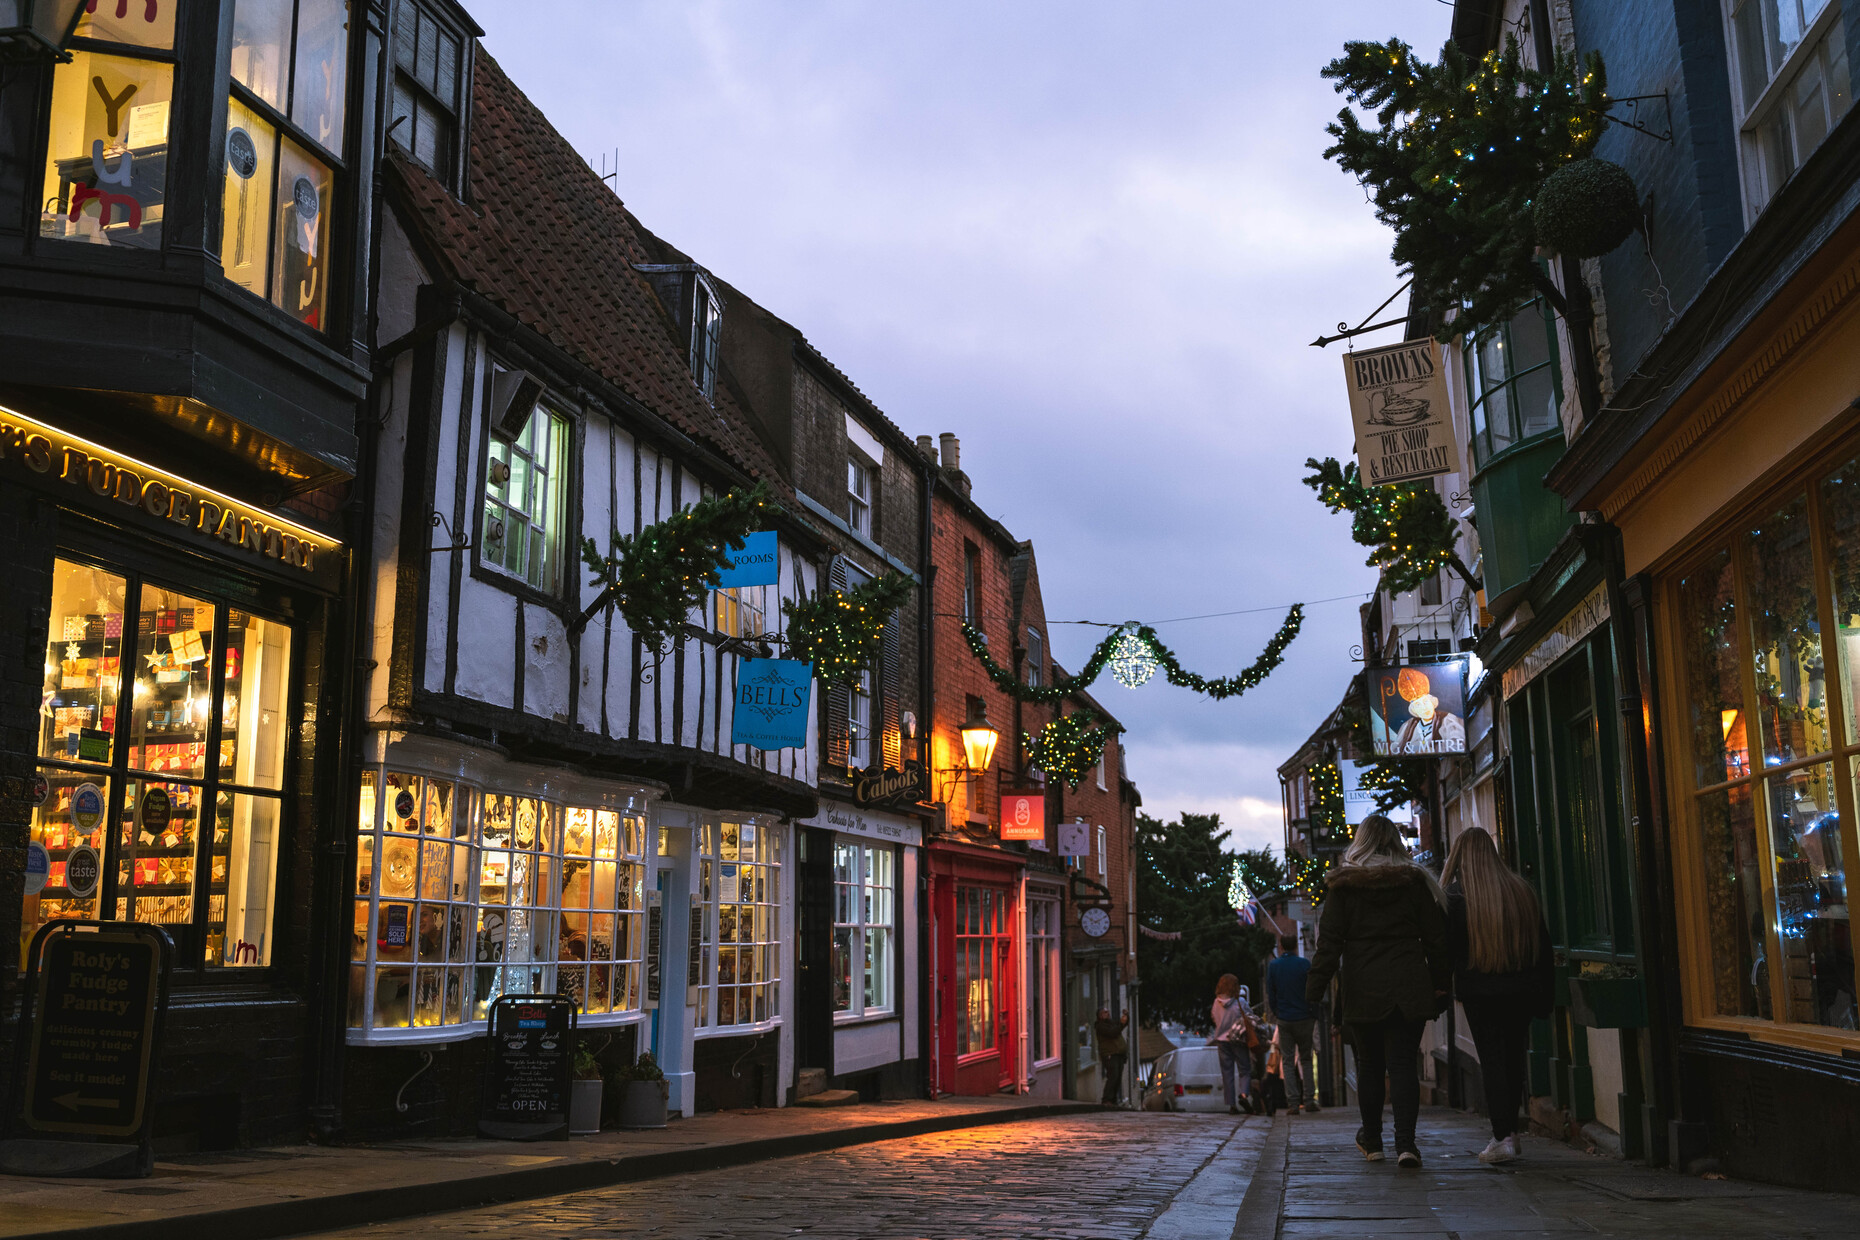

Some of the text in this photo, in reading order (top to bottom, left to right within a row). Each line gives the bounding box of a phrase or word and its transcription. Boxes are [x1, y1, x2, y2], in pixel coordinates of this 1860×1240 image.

[231, 142, 254, 167] taste
[296, 189, 316, 210] taste
[1354, 346, 1434, 387] BROWNS
[1381, 427, 1430, 455] PIE SHOP
[1370, 445, 1449, 478] & RESTAURANT
[61, 445, 192, 527] FUDGE
[197, 499, 319, 572] PANTRY
[734, 553, 774, 566] ROOMS
[740, 683, 807, 708] BELLS'
[1374, 738, 1465, 756] WIG & MITRE
[857, 770, 919, 802] Cahoots
[149, 802, 166, 811] Fudge
[150, 793, 166, 802] Vegan
[70, 866, 96, 878] taste
[71, 950, 130, 972] Roly's
[68, 972, 128, 994] Fudge
[61, 993, 131, 1016] Pantry
[46, 1024, 140, 1040] delicious creamy
[50, 1038, 133, 1052] crumbly fudge
[62, 1051, 120, 1063] made here
[50, 1069, 127, 1086] See it made!
[512, 1100, 547, 1111] OPEN
